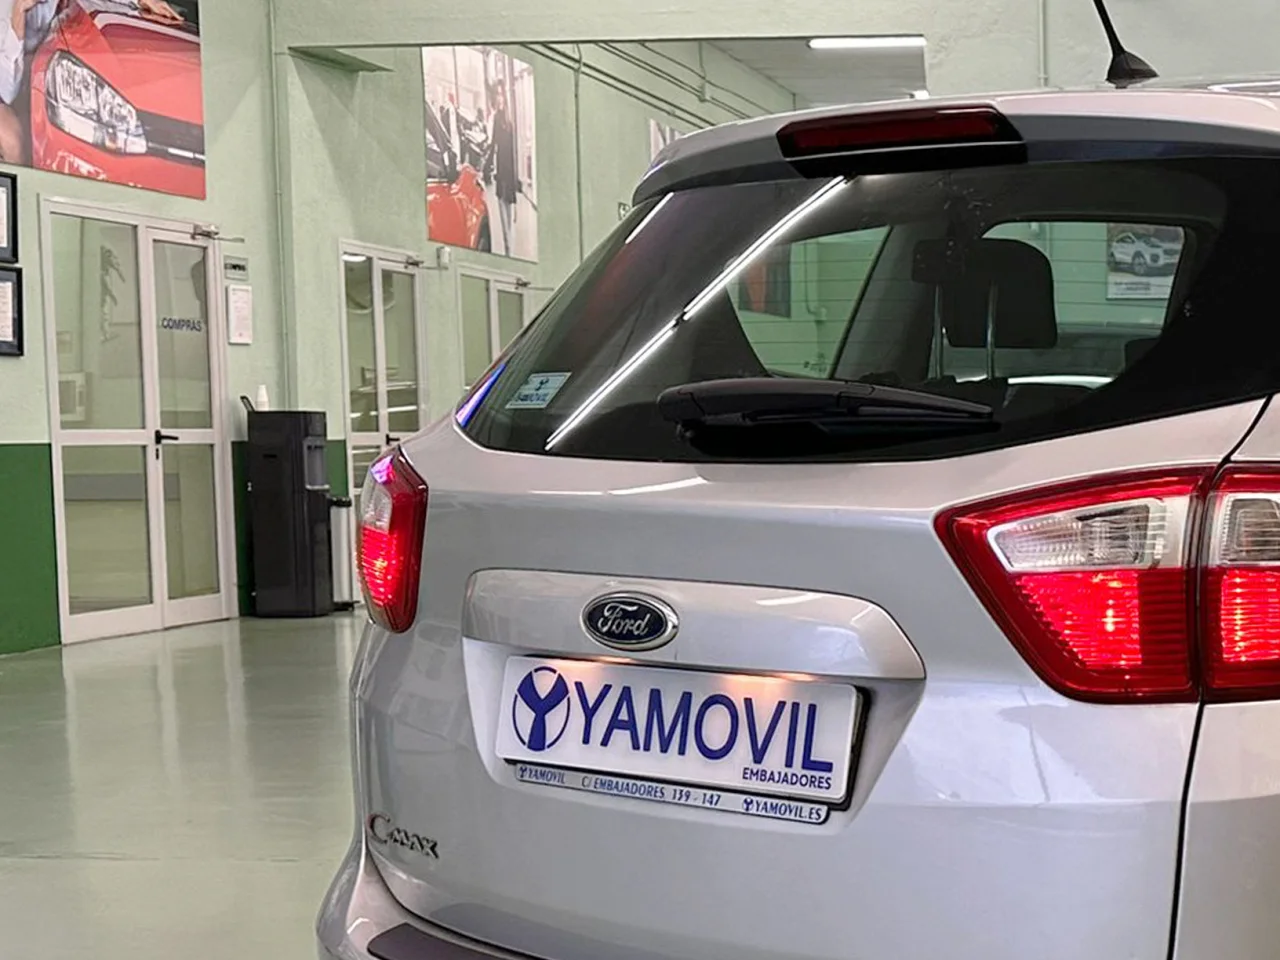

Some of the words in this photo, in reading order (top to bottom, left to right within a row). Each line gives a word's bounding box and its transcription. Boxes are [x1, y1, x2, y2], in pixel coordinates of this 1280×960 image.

[161, 317, 202, 332] COMPRAS
[598, 603, 650, 635] Ford
[574, 681, 833, 773] YAMOVIL
[528, 768, 566, 785] YAMOVIL
[593, 777, 665, 799] EMBAJADORES
[672, 788, 691, 801] 139
[702, 792, 722, 807] 147
[755, 803, 822, 821] YAMOVIL.ES
[742, 767, 832, 790] EMBAJADORES
